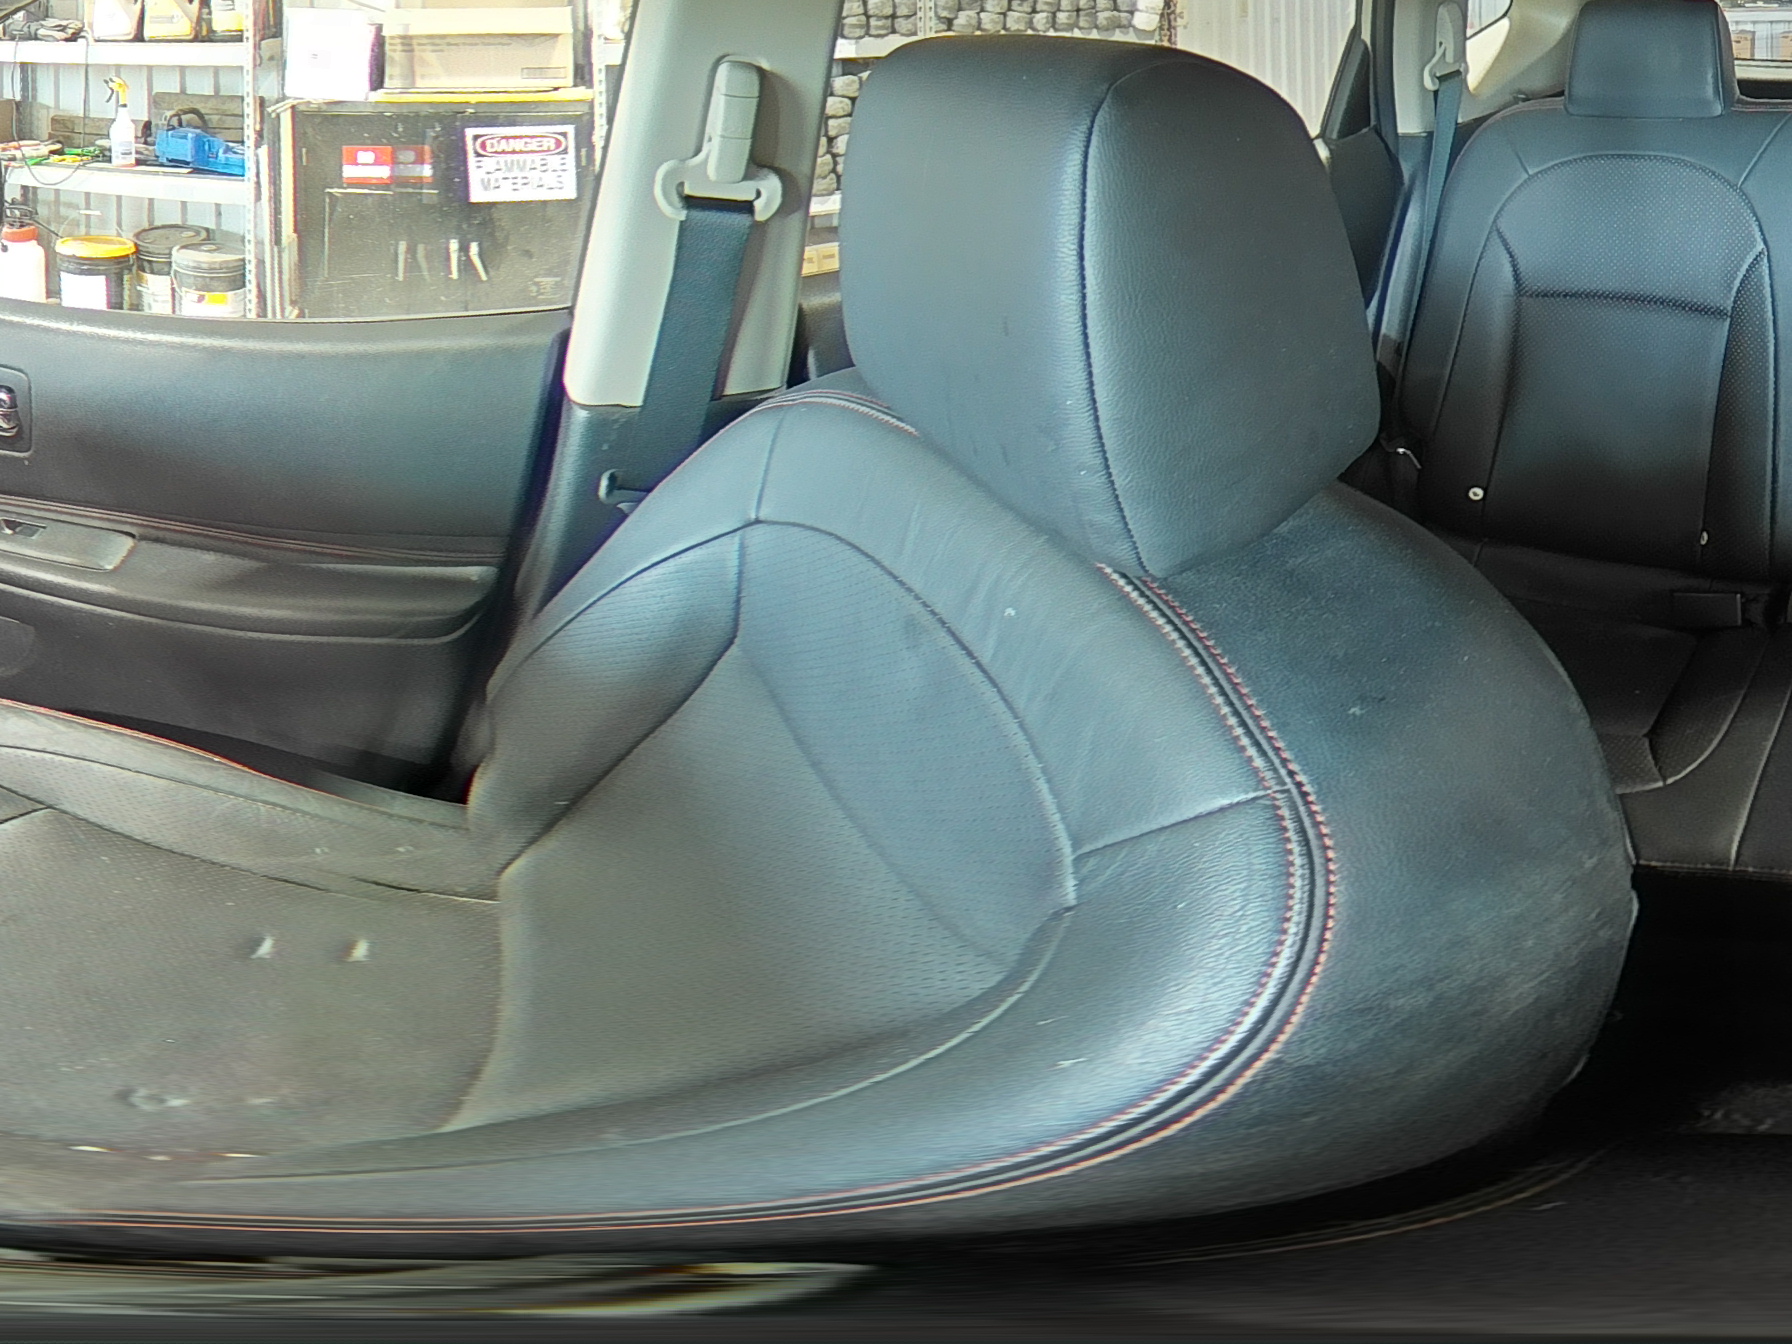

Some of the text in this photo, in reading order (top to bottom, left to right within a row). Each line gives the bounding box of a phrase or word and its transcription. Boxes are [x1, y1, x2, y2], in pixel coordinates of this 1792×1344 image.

[485, 137, 555, 153] DANGER
[475, 157, 569, 174] FLAMMABLE
[480, 175, 565, 191] MATERIALS
